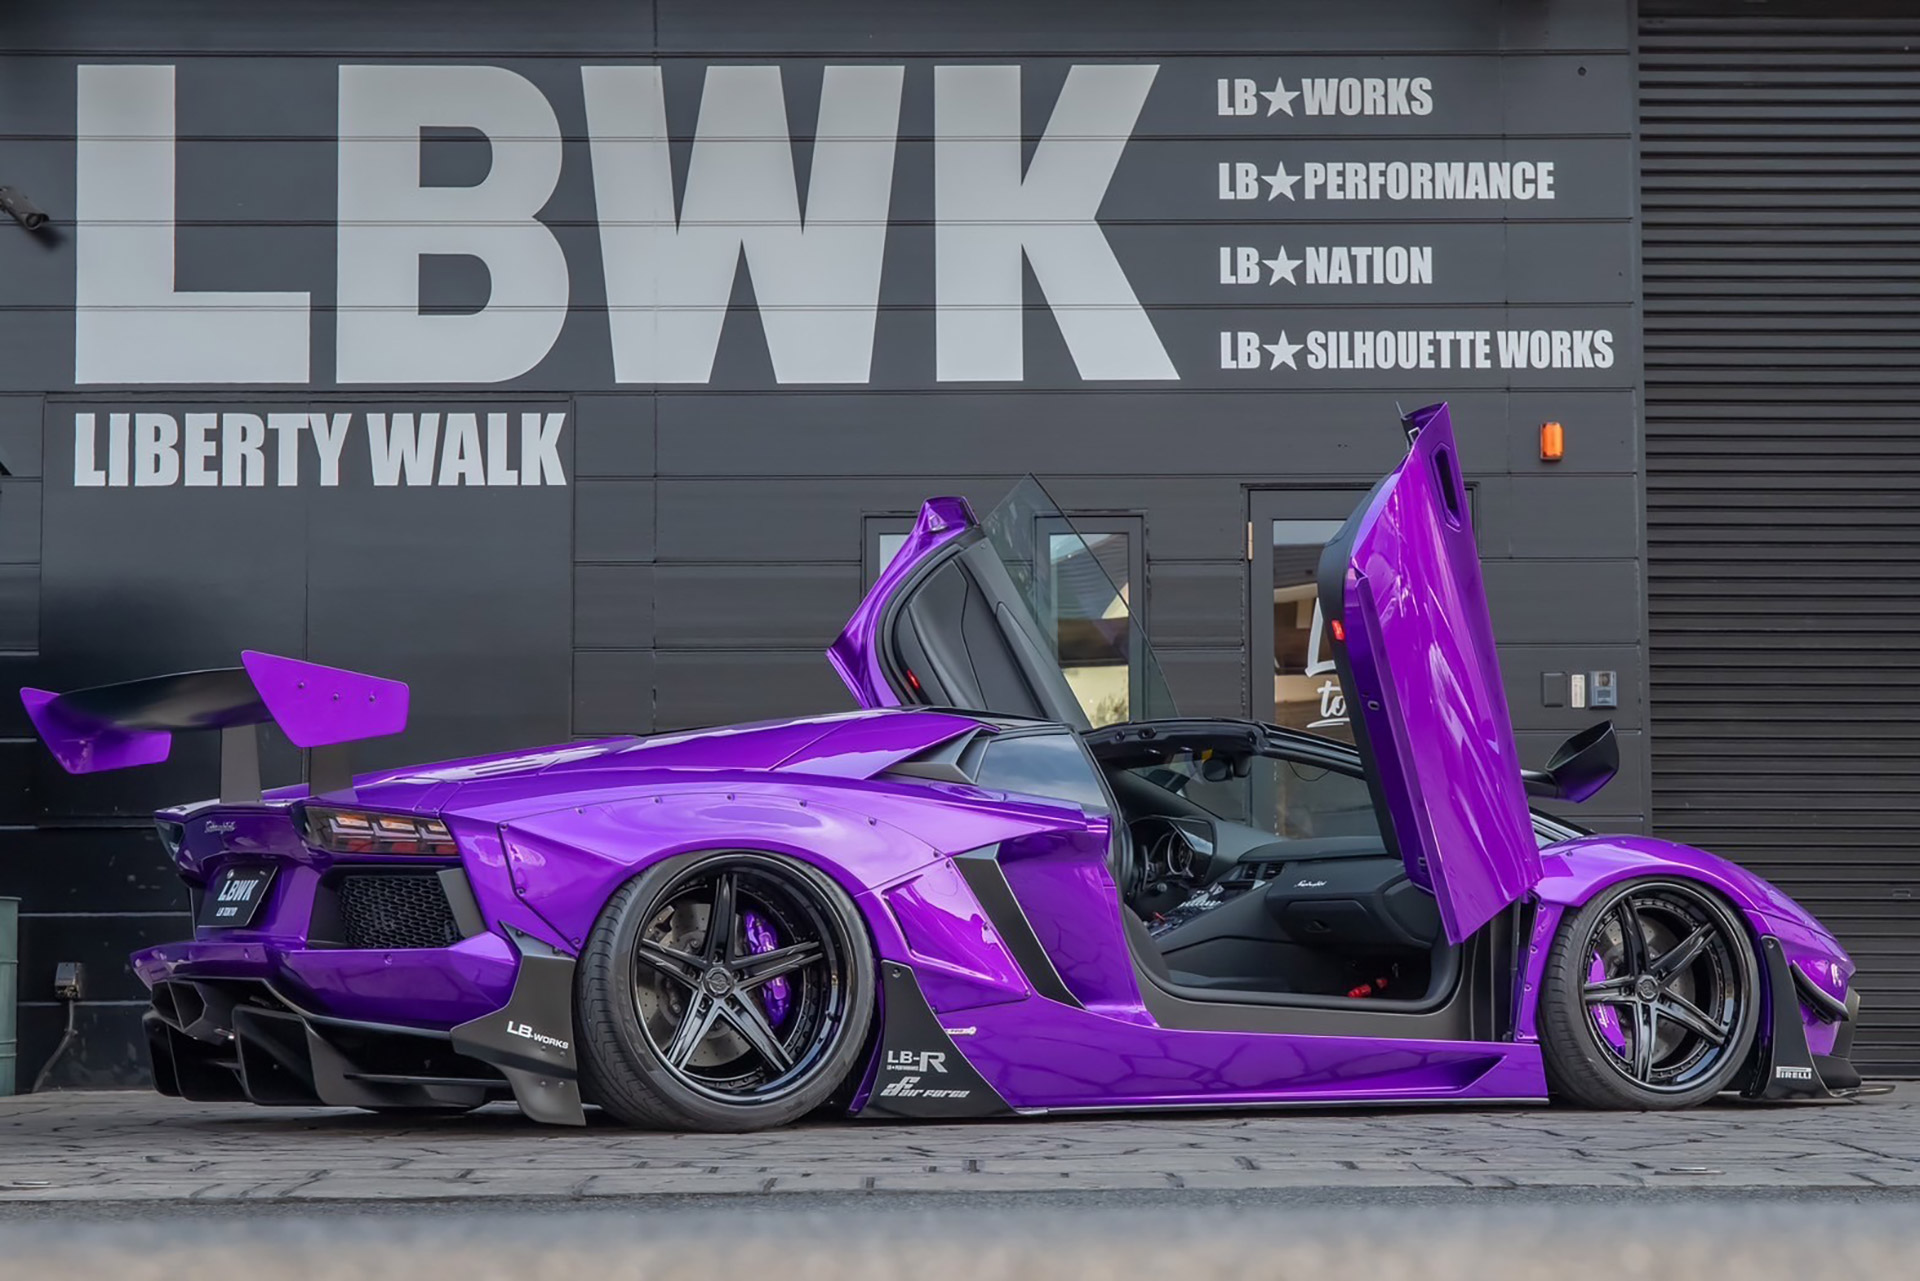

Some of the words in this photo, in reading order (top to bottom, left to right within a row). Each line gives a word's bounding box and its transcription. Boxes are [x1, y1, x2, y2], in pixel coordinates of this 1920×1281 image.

[75, 64, 1180, 385] LBWK
[1496, 329, 1615, 369] WORKS
[74, 412, 353, 487] LIBERTY
[366, 412, 567, 487] WALK
[218, 879, 259, 901] LBWK
[1776, 1066, 1812, 1080] PIRELLI
